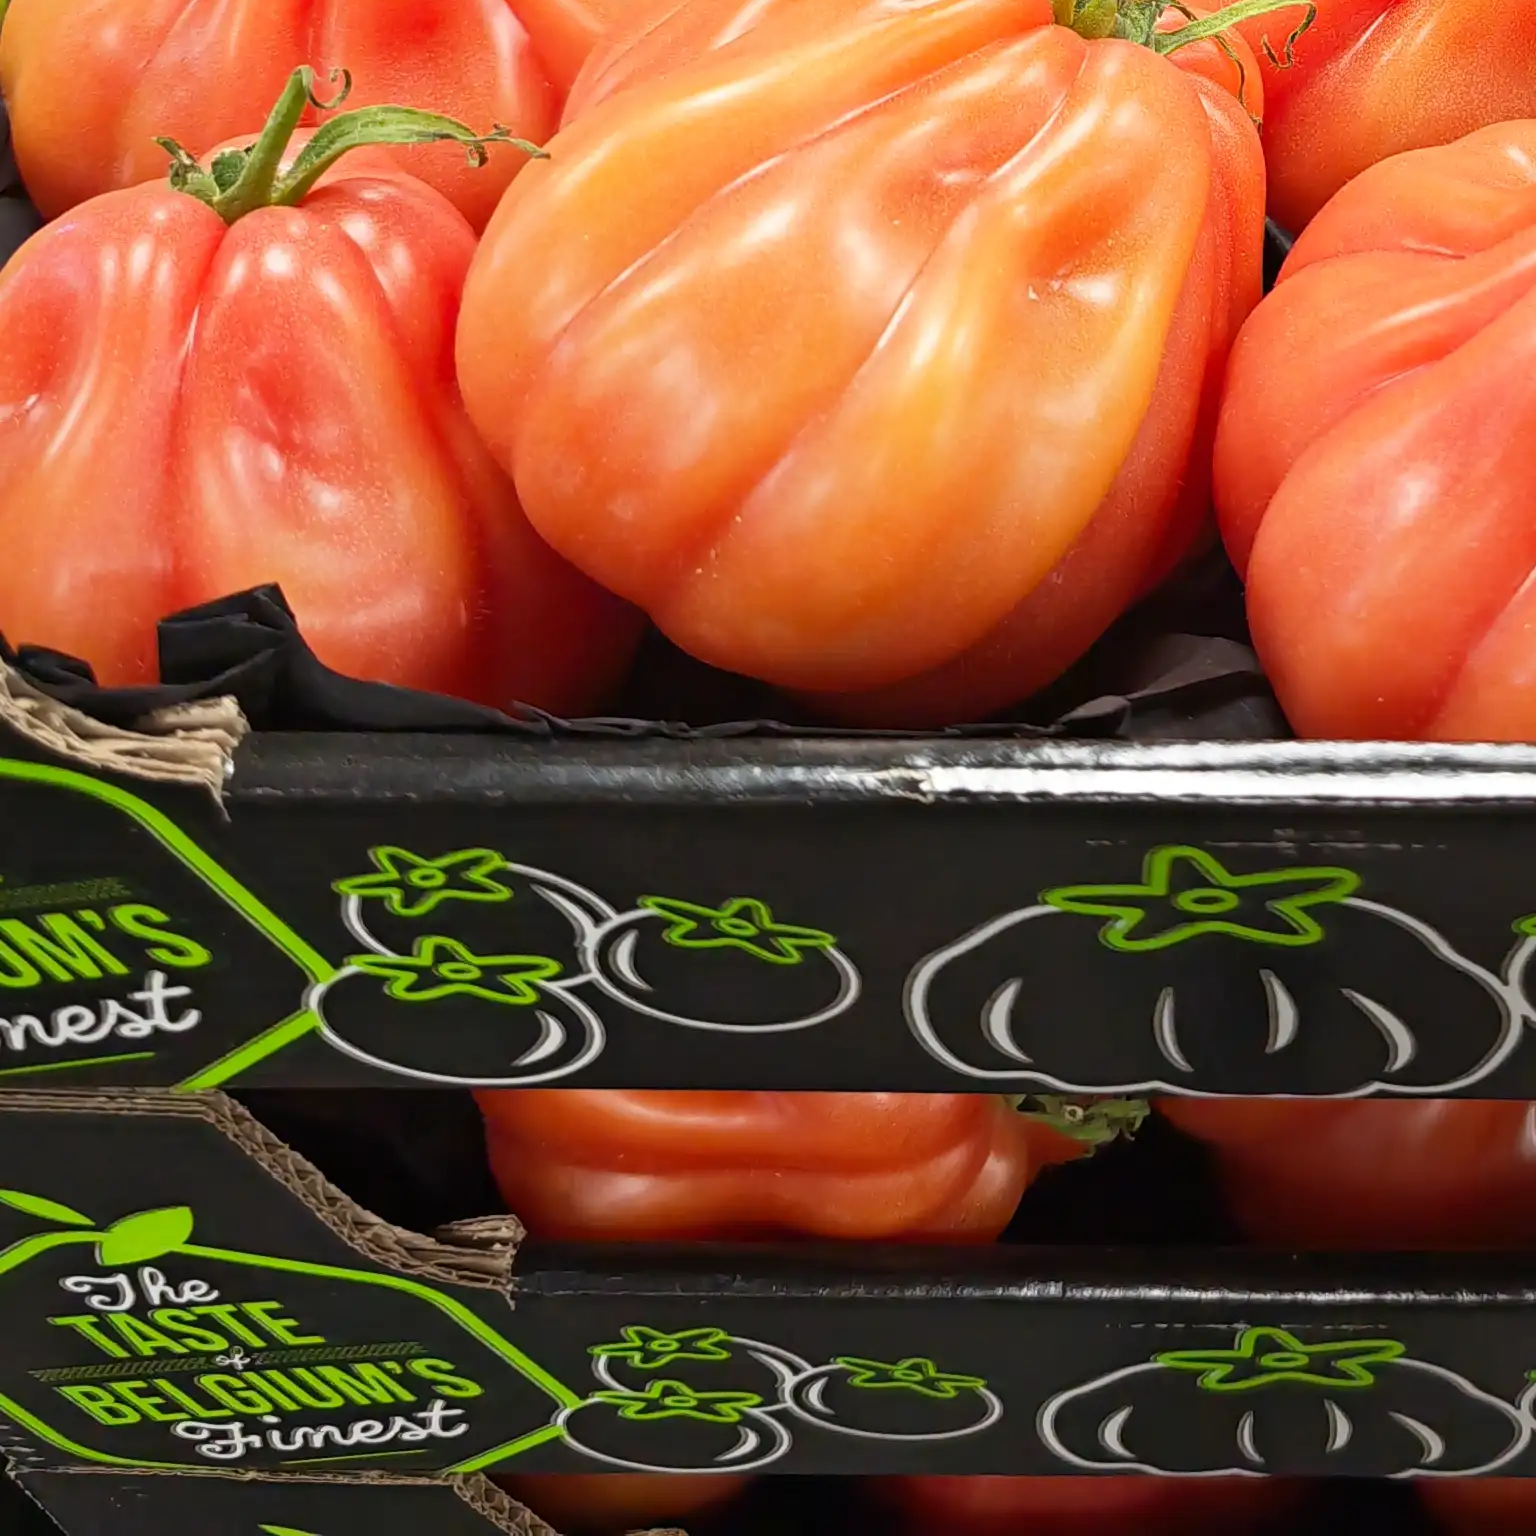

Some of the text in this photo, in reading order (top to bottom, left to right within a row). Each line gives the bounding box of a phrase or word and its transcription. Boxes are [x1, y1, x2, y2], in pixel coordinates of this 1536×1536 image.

[59, 1266, 220, 1311] The
[47, 1301, 327, 1358] TASTE
[53, 1358, 484, 1426] BELGIUM'S
[170, 1399, 470, 1459] Finest
